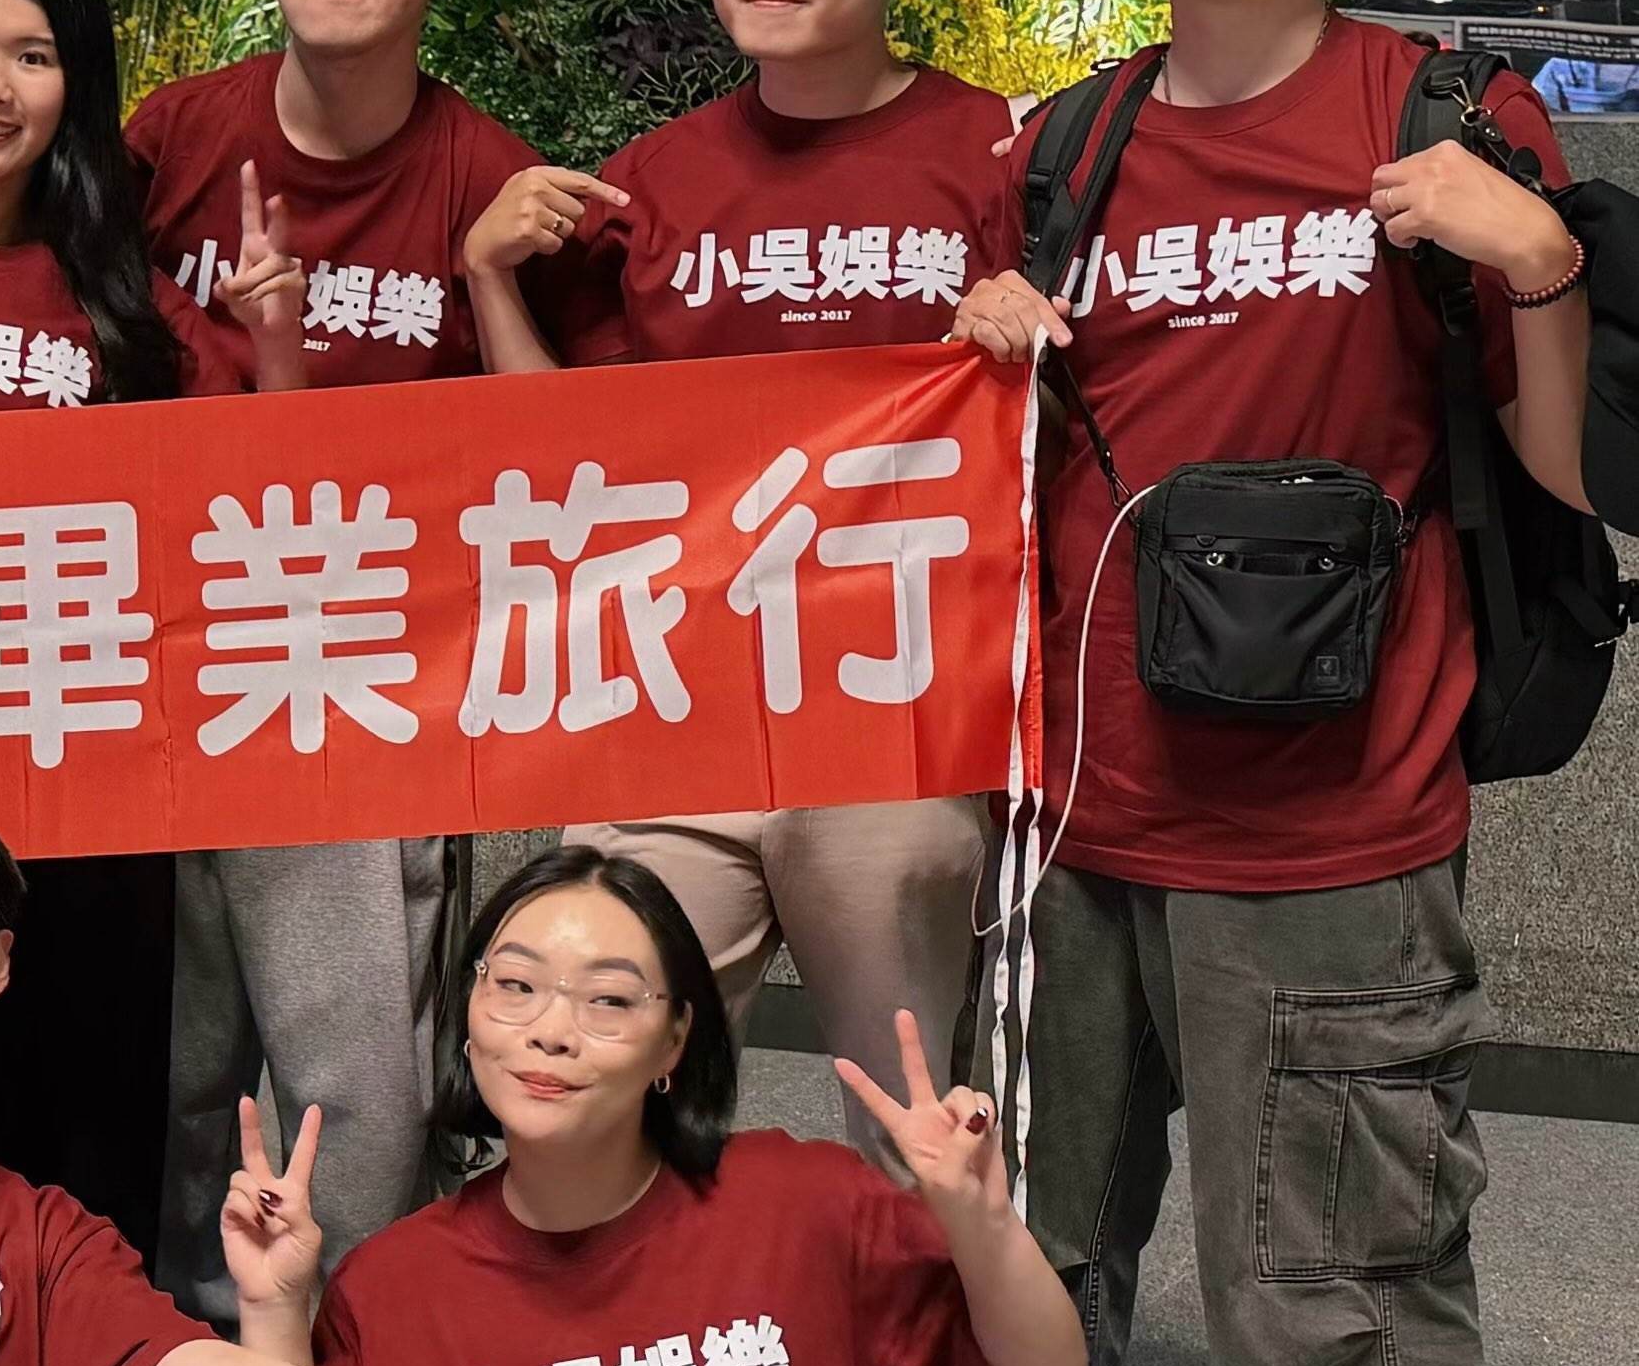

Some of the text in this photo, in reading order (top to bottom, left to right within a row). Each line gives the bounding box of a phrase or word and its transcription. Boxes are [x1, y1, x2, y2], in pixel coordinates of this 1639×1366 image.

[670, 225, 968, 307] 小吳娛樂
[1062, 208, 1378, 318] 小吳娛樂
[175, 239, 445, 348] 小娛樂
[781, 310, 851, 322] since 2017
[1168, 311, 1239, 328] since 2017
[303, 338, 330, 351] 2017
